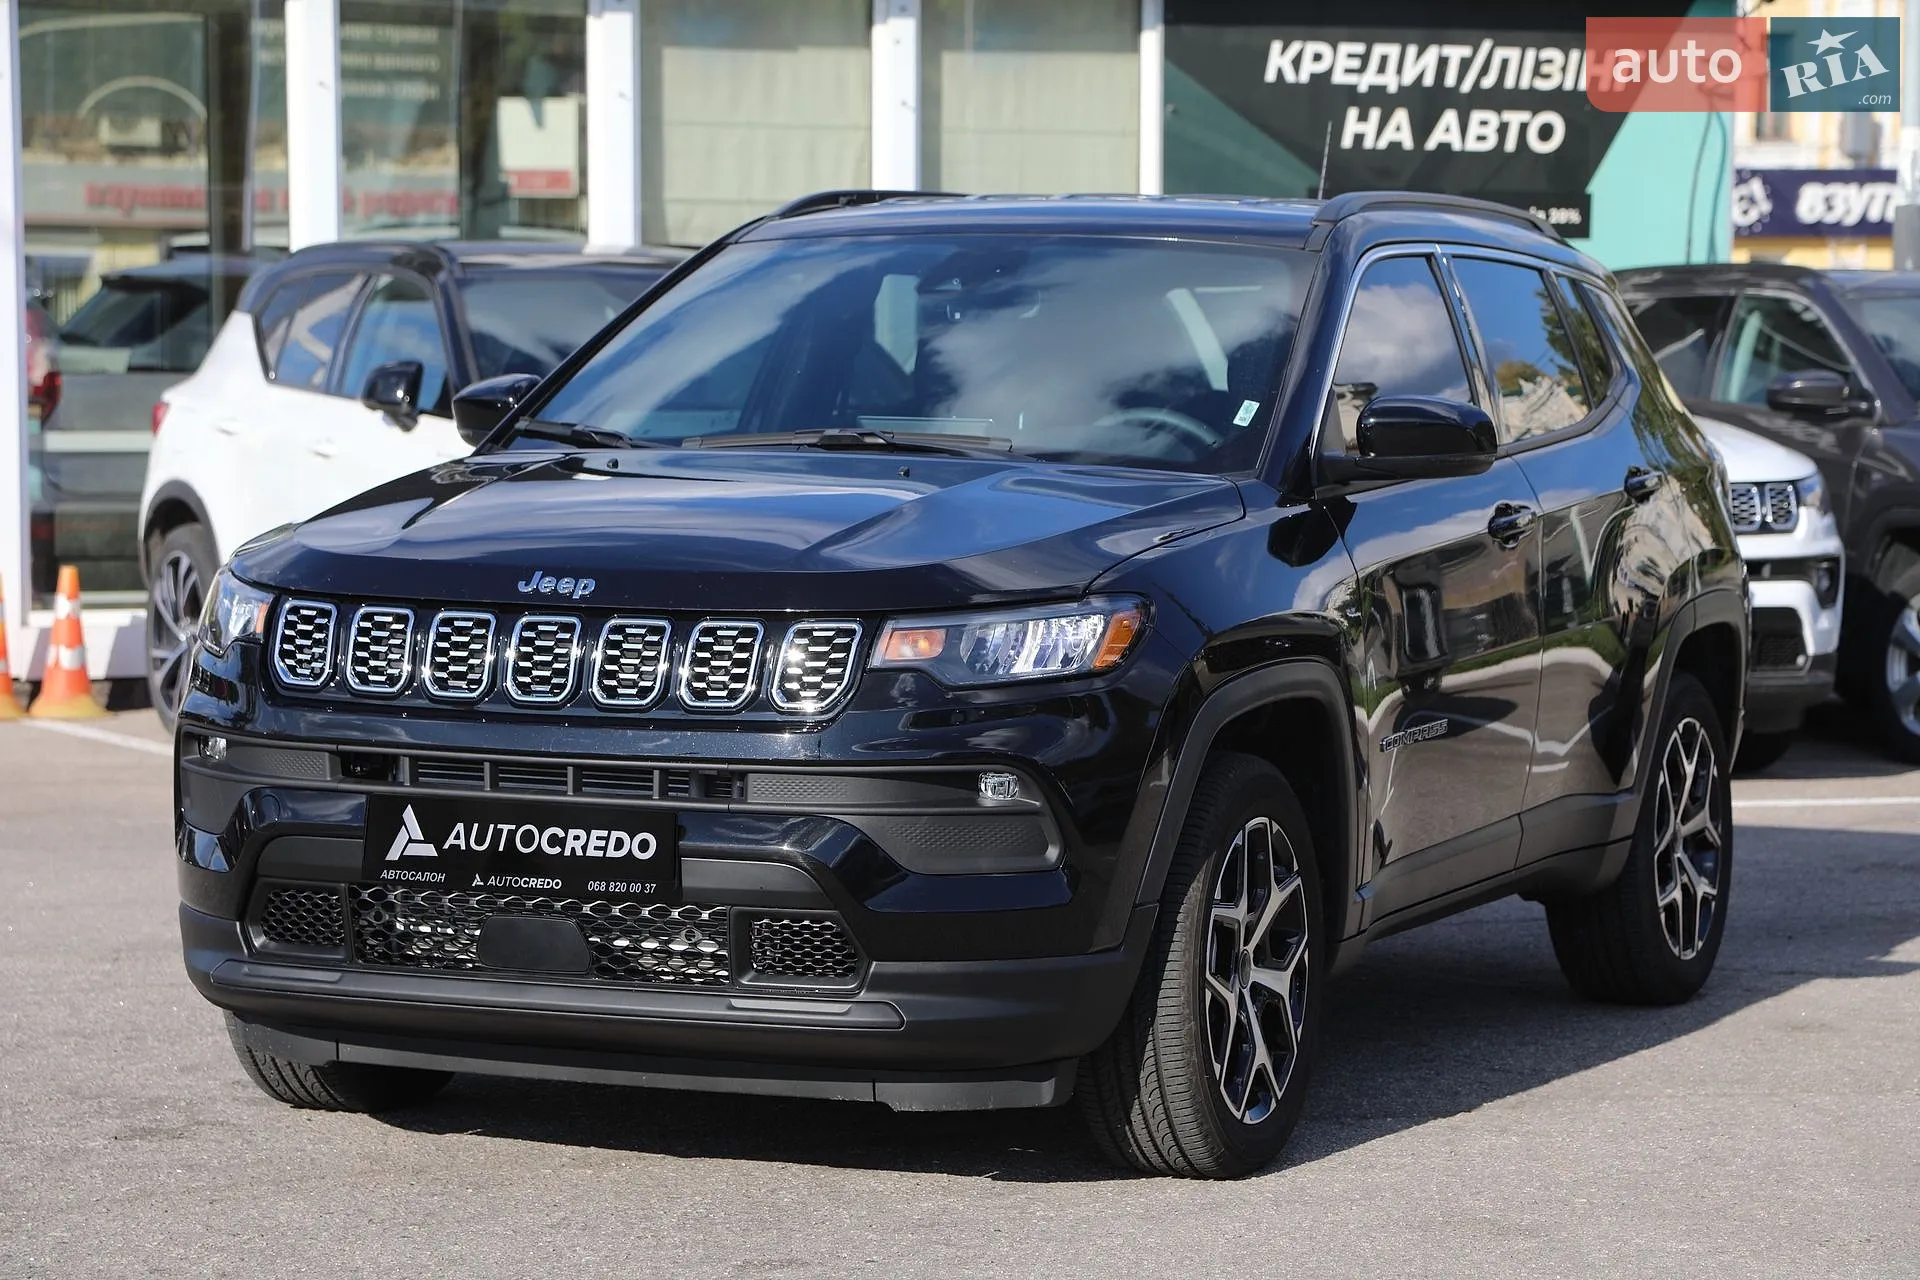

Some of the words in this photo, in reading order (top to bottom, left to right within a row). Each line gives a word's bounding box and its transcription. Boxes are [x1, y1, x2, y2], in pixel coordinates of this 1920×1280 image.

[1340, 105, 1415, 151] НА
[1423, 108, 1566, 154] АВТО
[517, 570, 597, 599] Jeep
[1383, 718, 1448, 752] COMPASS
[442, 822, 657, 861] AUTOCREDO
[380, 869, 446, 883] АВТОСАЛОН
[487, 875, 562, 890] AUTOCREDO
[587, 880, 607, 892] 068
[608, 881, 627, 893] 820
[629, 882, 642, 893] 00
[644, 883, 657, 894] 37
